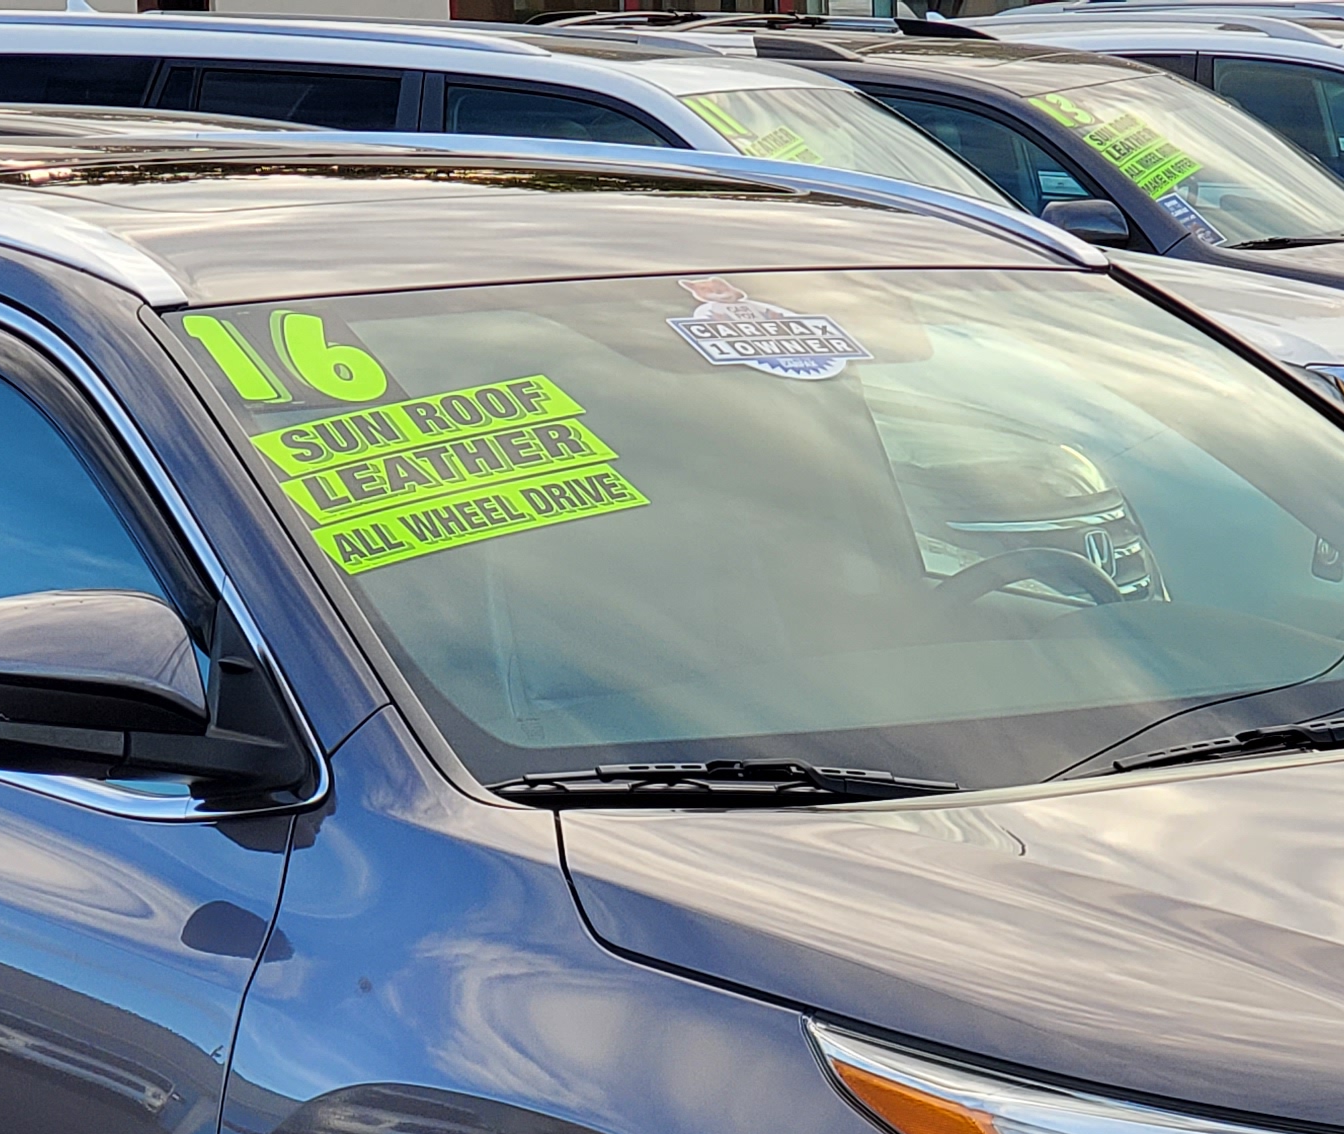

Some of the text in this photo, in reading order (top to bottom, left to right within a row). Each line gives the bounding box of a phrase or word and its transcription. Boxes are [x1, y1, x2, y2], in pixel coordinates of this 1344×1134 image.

[1028, 93, 1095, 128] 13
[1108, 128, 1161, 162] LEATHER
[1124, 162, 1145, 180] ALL
[183, 310, 388, 403] 16
[690, 320, 836, 339] CARFAX
[279, 379, 554, 464] SUN ROOF
[301, 421, 593, 511] LEATHER
[332, 470, 631, 565] ALL WHEEL DRIVE
